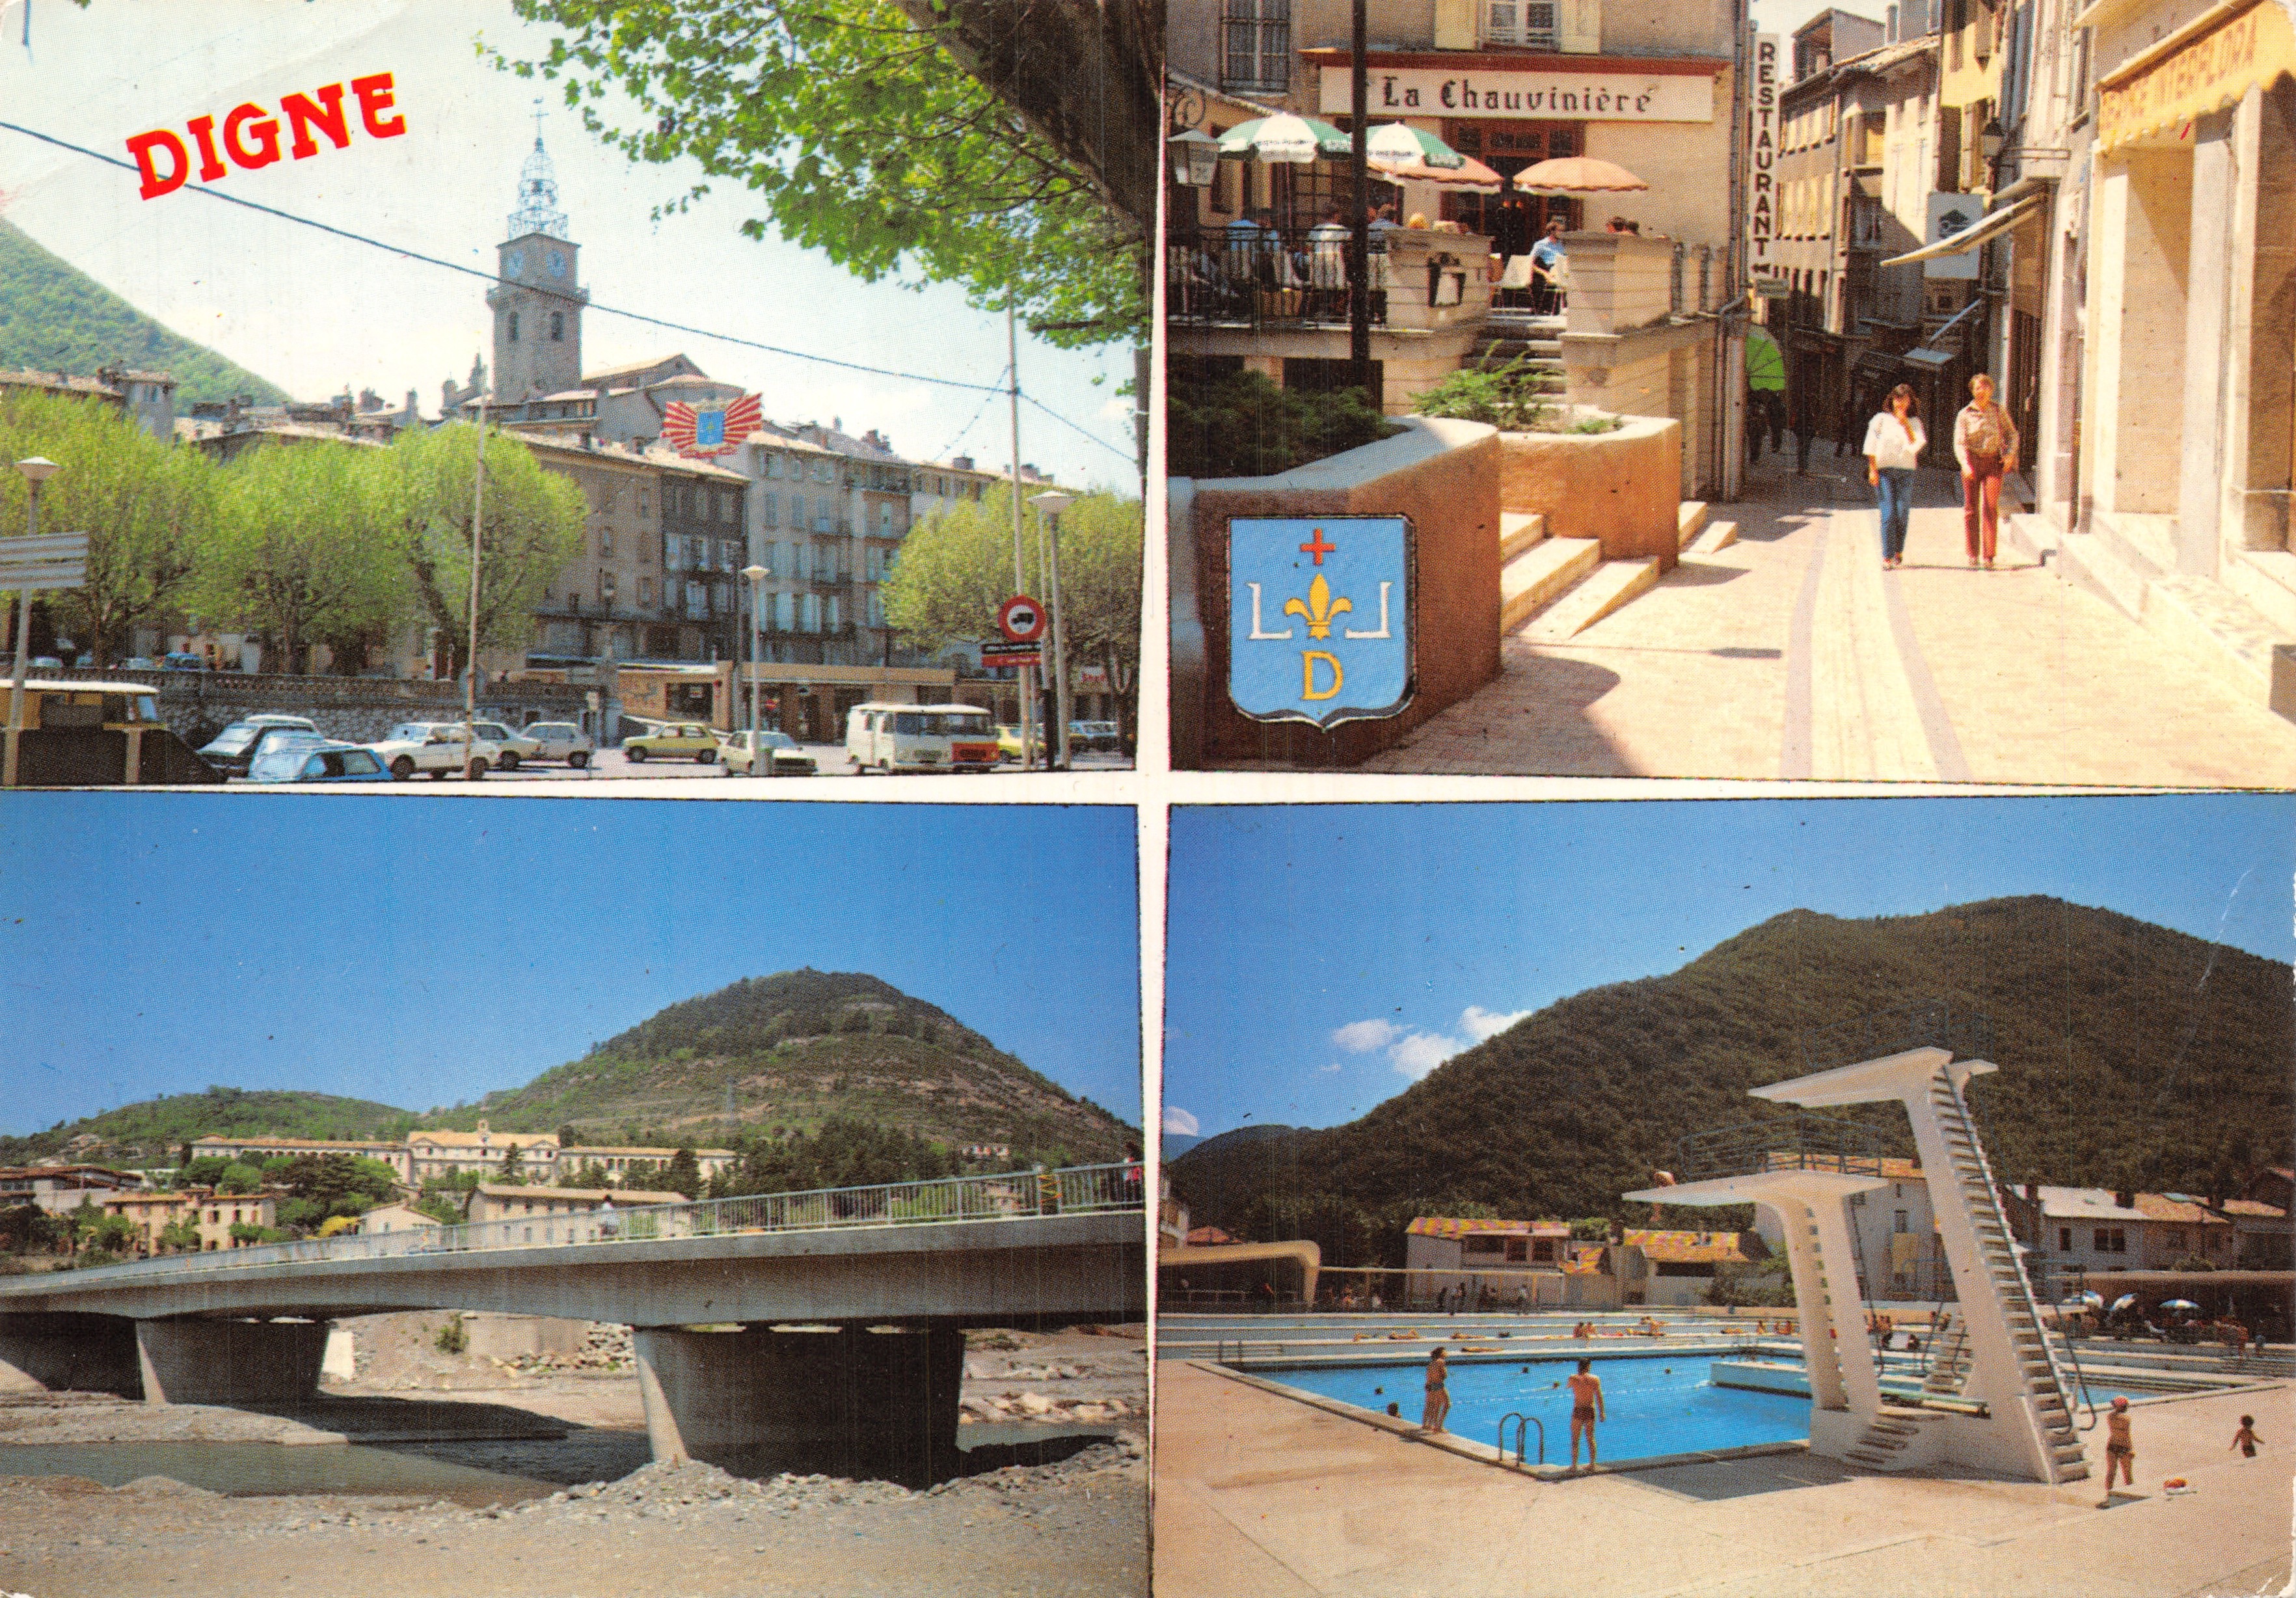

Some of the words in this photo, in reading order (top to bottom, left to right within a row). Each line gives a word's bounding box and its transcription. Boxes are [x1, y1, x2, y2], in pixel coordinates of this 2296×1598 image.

[1383, 75, 1420, 107] La
[1753, 42, 1776, 256] RESTAURANT
[1301, 650, 1344, 701] D
